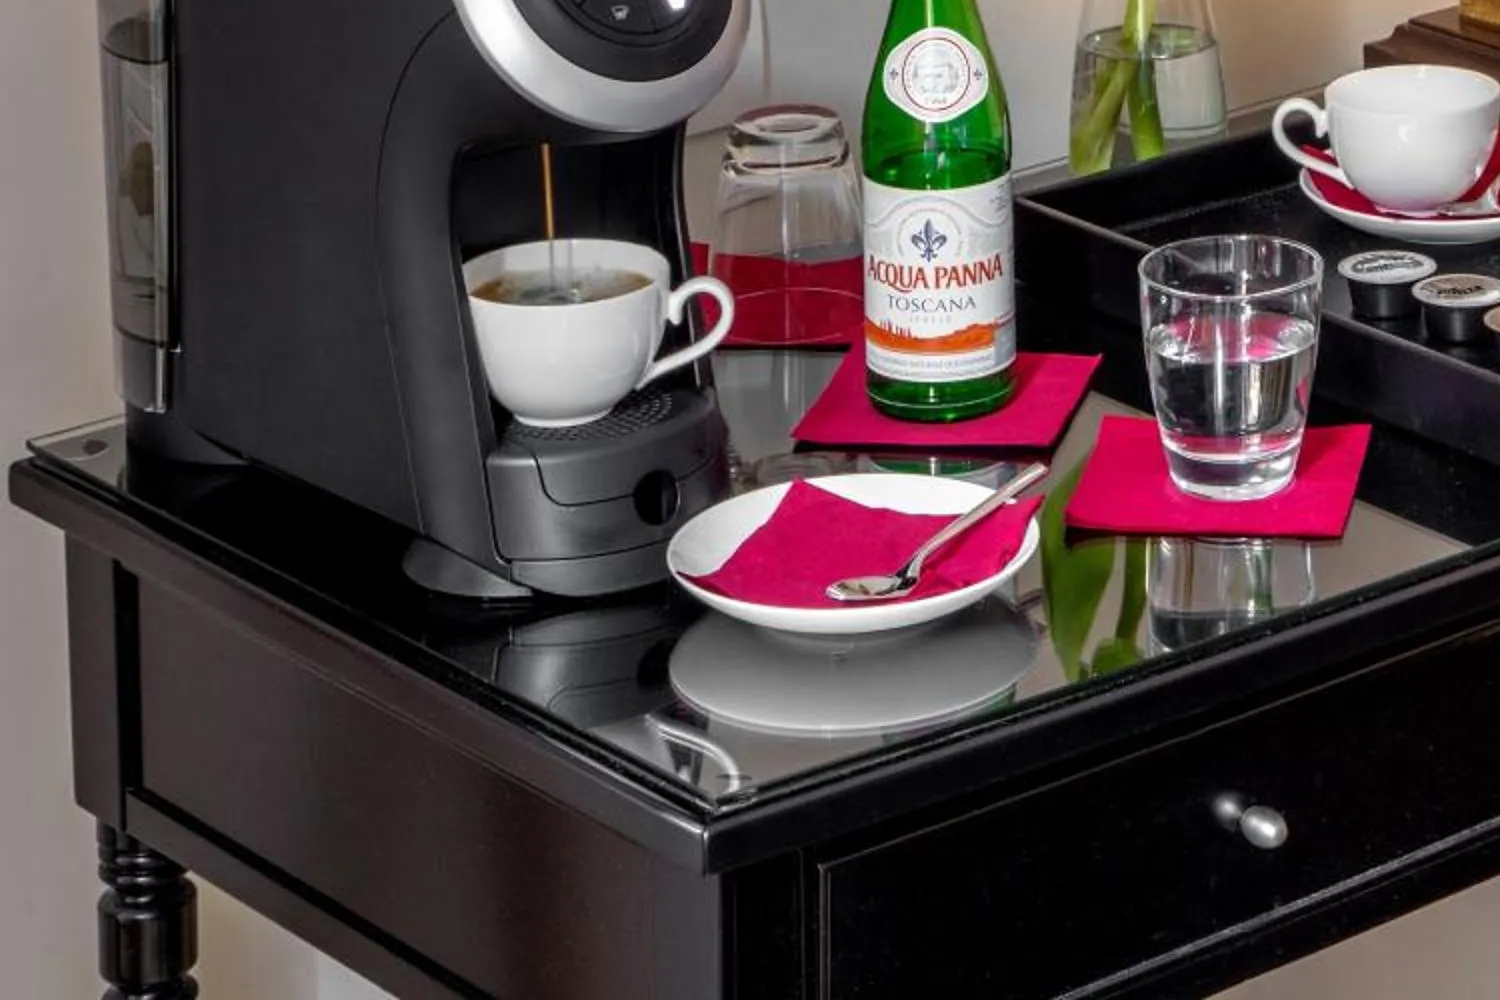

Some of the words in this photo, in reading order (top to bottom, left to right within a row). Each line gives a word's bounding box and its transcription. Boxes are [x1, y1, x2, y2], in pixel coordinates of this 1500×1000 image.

[867, 254, 930, 293] ACQUA
[934, 252, 1004, 290] PANNA
[888, 294, 977, 313] TOSCANA
